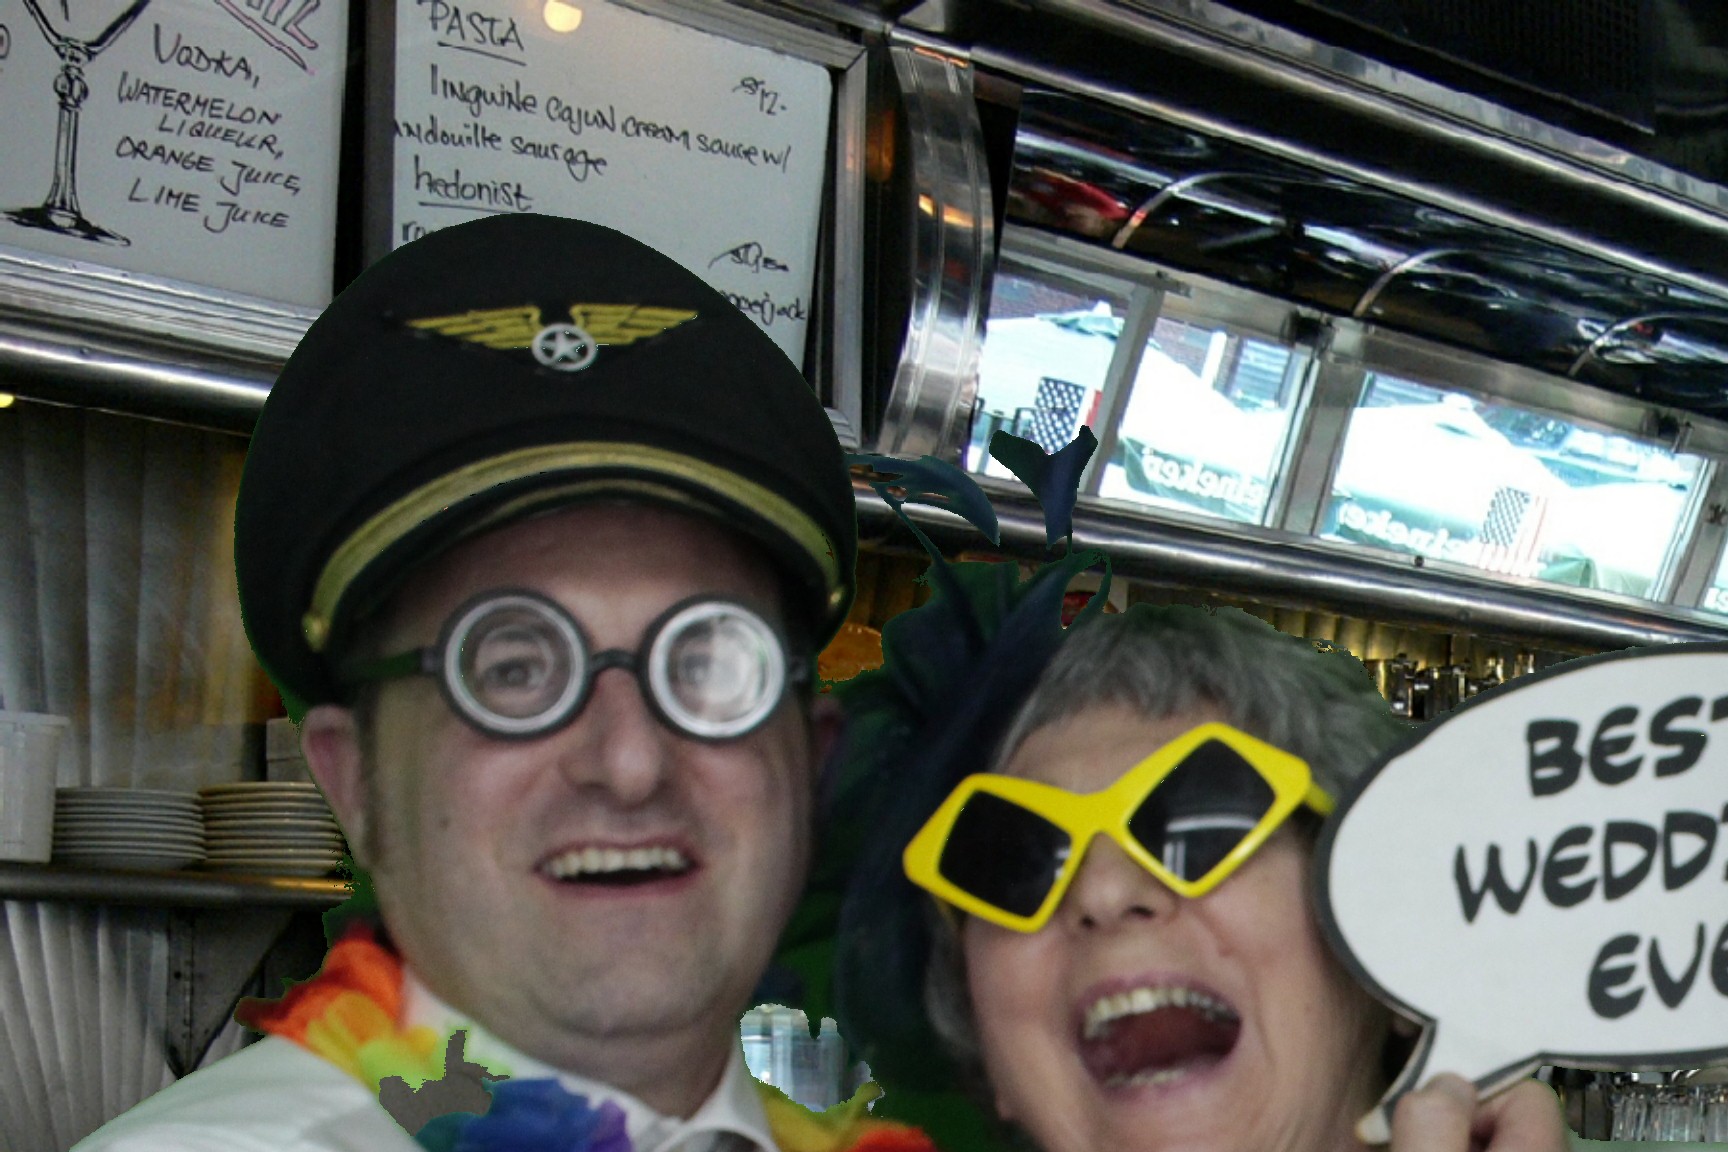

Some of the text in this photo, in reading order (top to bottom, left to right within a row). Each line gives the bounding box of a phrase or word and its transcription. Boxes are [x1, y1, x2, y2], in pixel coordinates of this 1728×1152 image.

[416, 0, 525, 51] PASTA
[118, 71, 282, 125] WATERMELON
[116, 135, 214, 172] ORANGE
[128, 177, 289, 233] LIME JUICE
